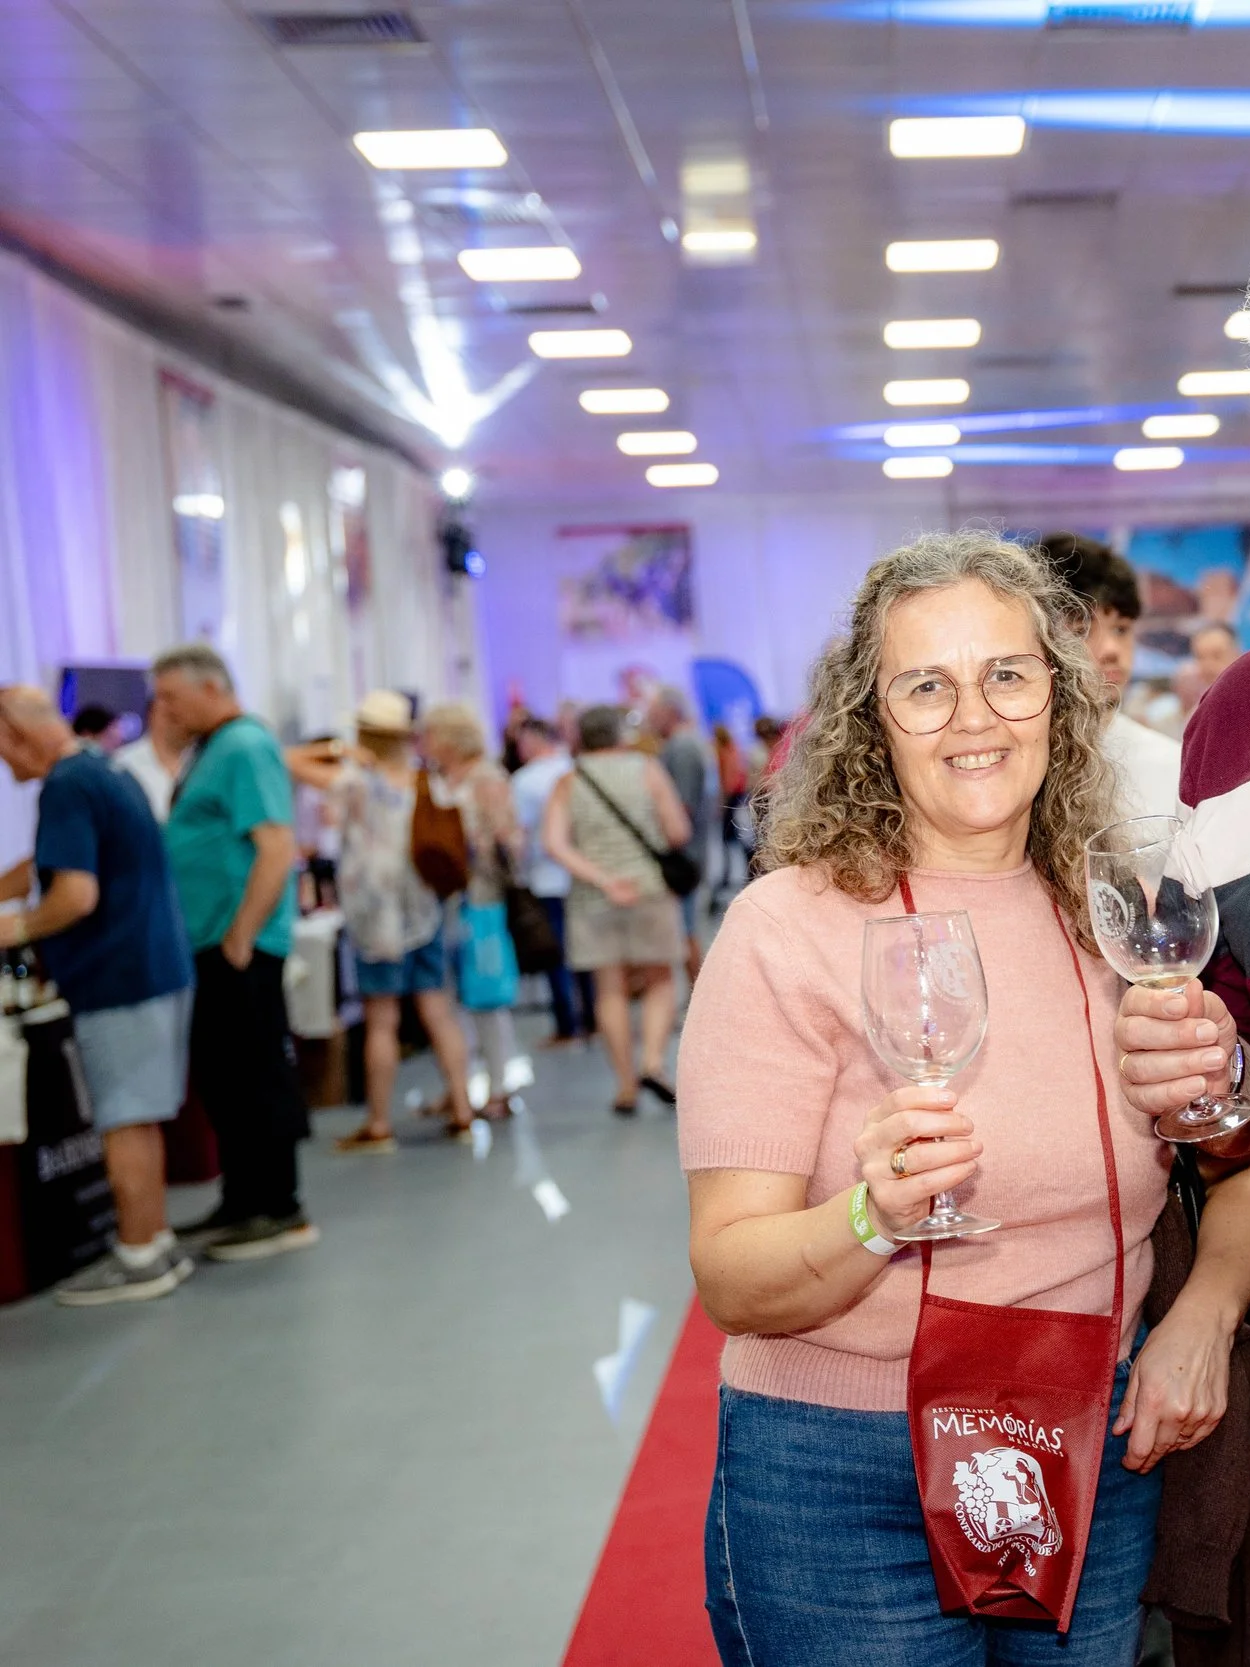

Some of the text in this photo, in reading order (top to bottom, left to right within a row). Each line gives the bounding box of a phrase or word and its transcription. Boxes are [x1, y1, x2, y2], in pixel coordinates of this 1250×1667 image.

[931, 1406, 996, 1414] RESTAURANTE
[954, 1501, 992, 1554] CONFRARIA
[1037, 1546, 1053, 1557] DE
[997, 1548, 1011, 1568] Tel:
